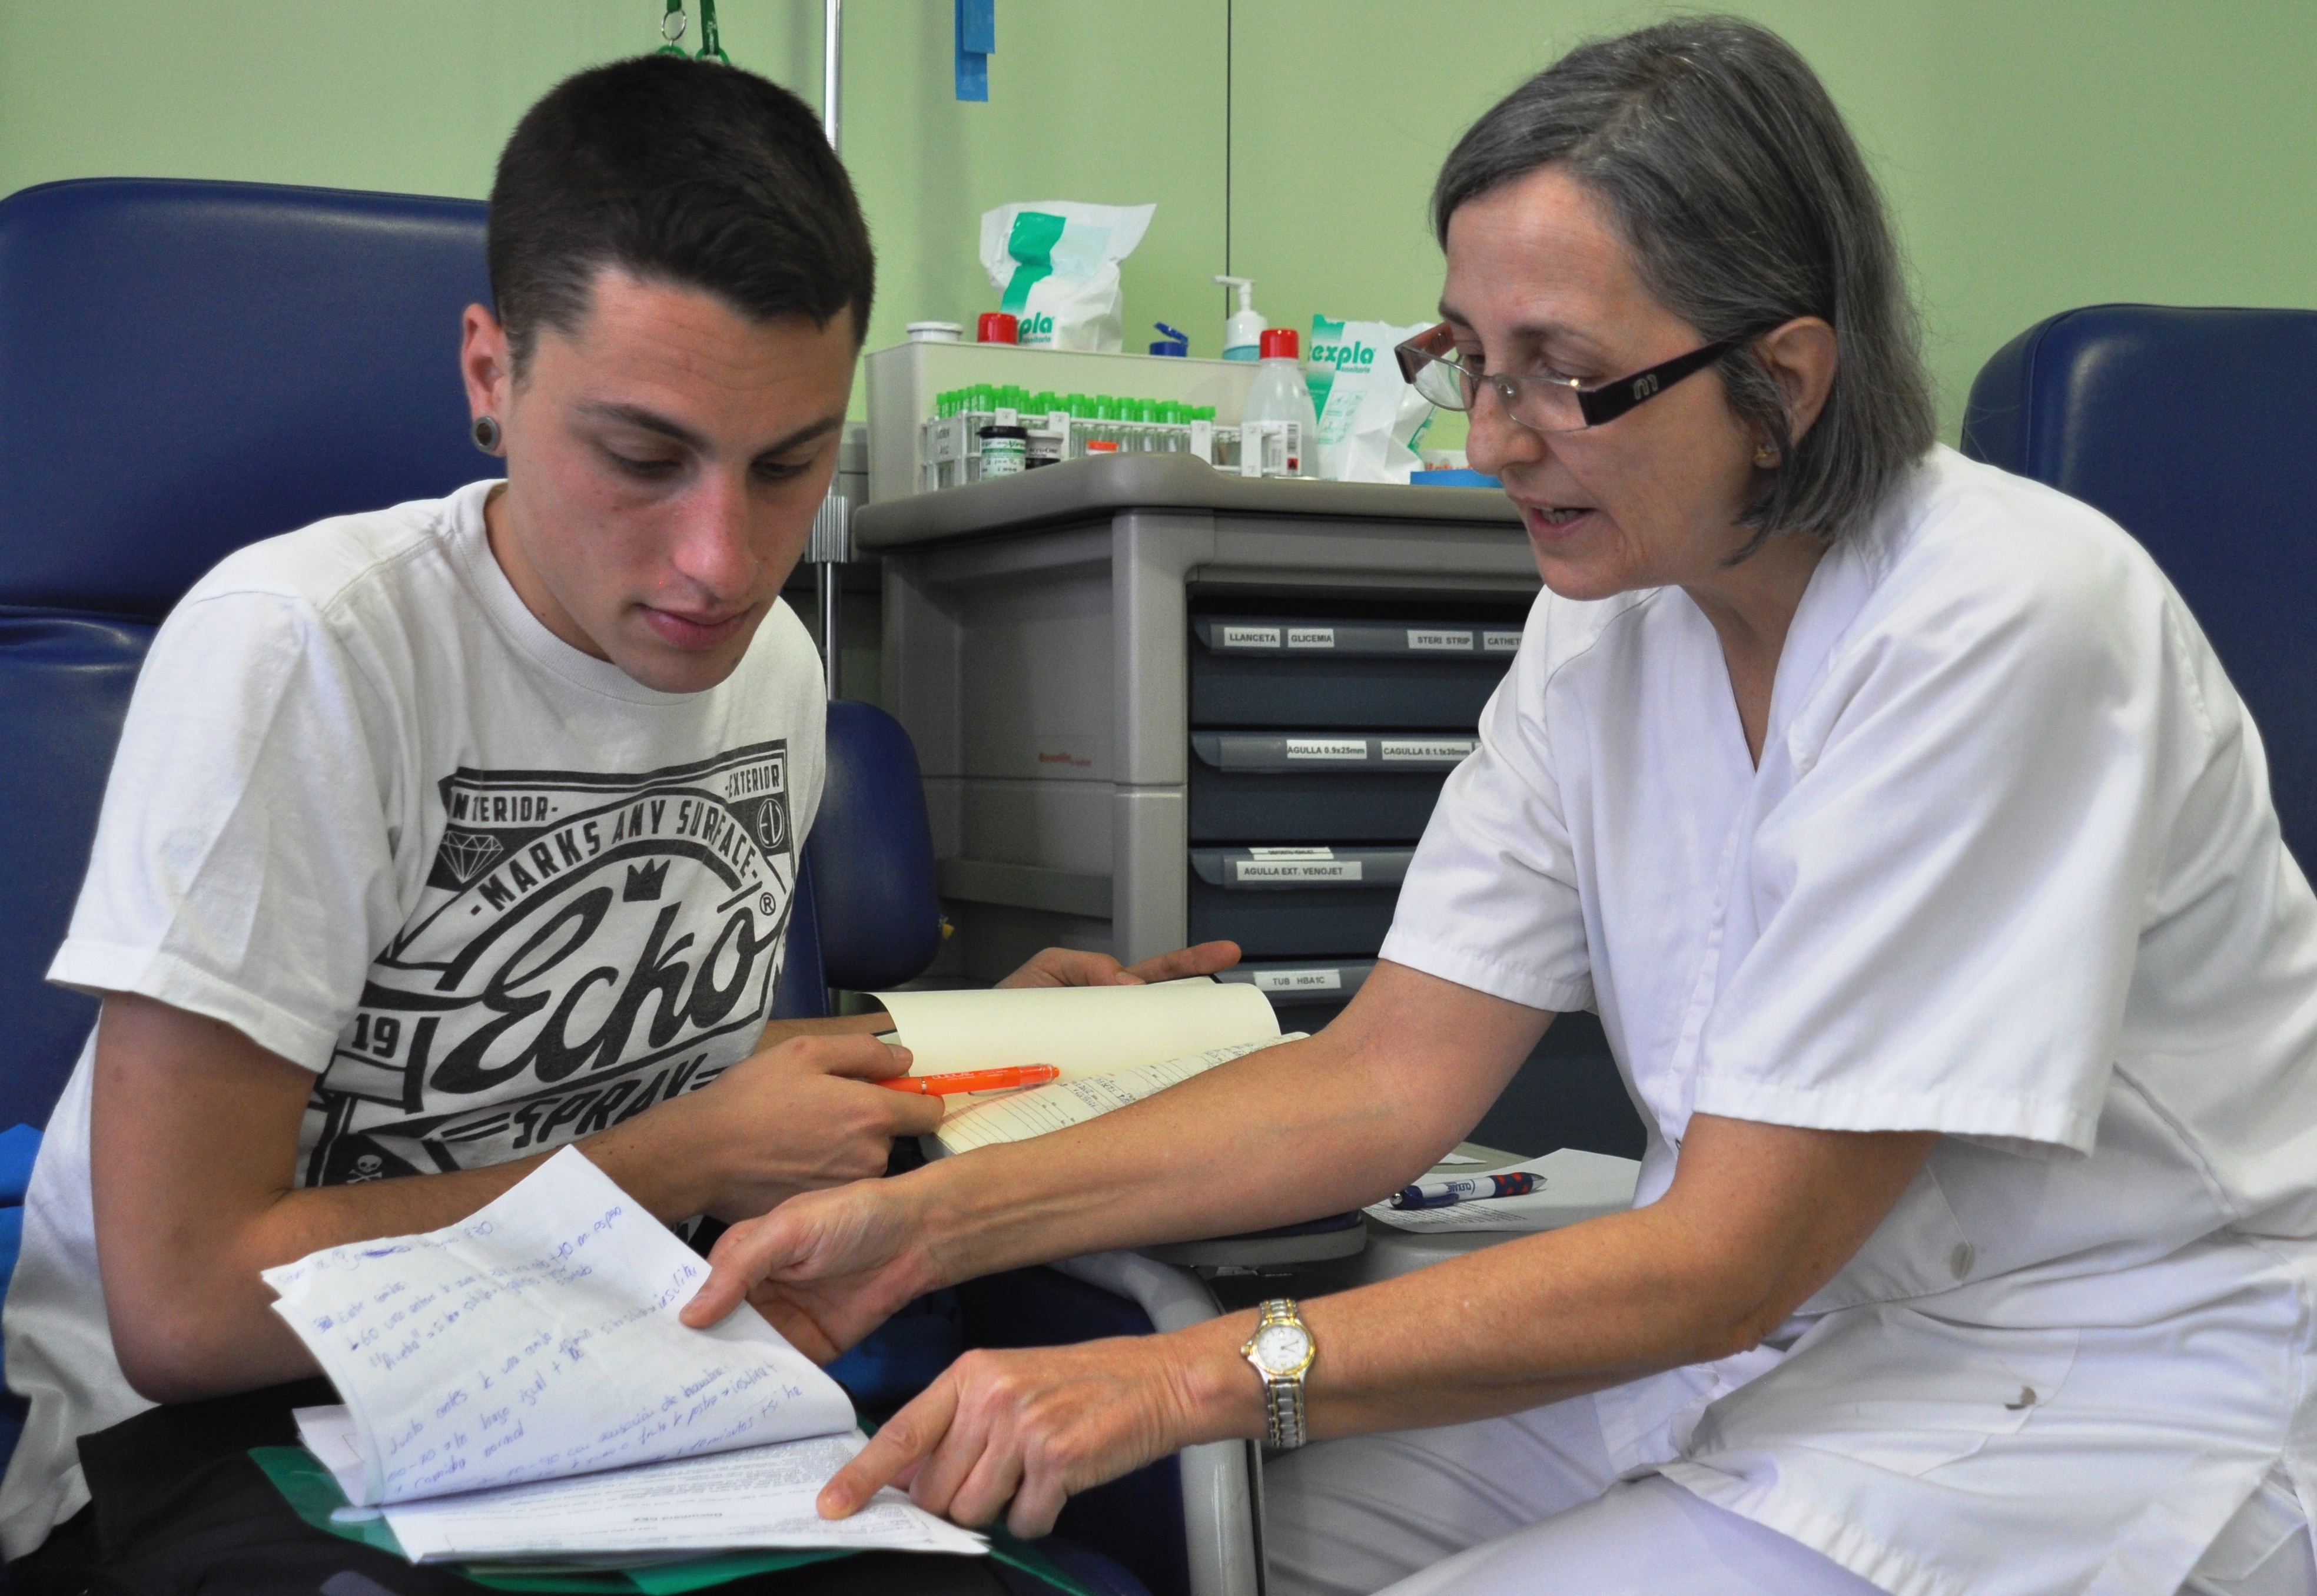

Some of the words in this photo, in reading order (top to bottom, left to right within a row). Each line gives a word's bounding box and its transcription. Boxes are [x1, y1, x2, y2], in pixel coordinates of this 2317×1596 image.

[1017, 312, 1053, 343] pla
[1230, 633, 1276, 642] LLANCETA
[1291, 634, 1332, 643] GLICEMIA
[1287, 746, 1322, 755] AGULLA
[611, 799, 666, 845] ANY
[1244, 867, 1279, 875] AGULLA
[1281, 867, 1300, 875] EXT.
[1303, 867, 1343, 875] VENOJET
[430, 887, 774, 1094] Ecko
[351, 1013, 401, 1059] 19
